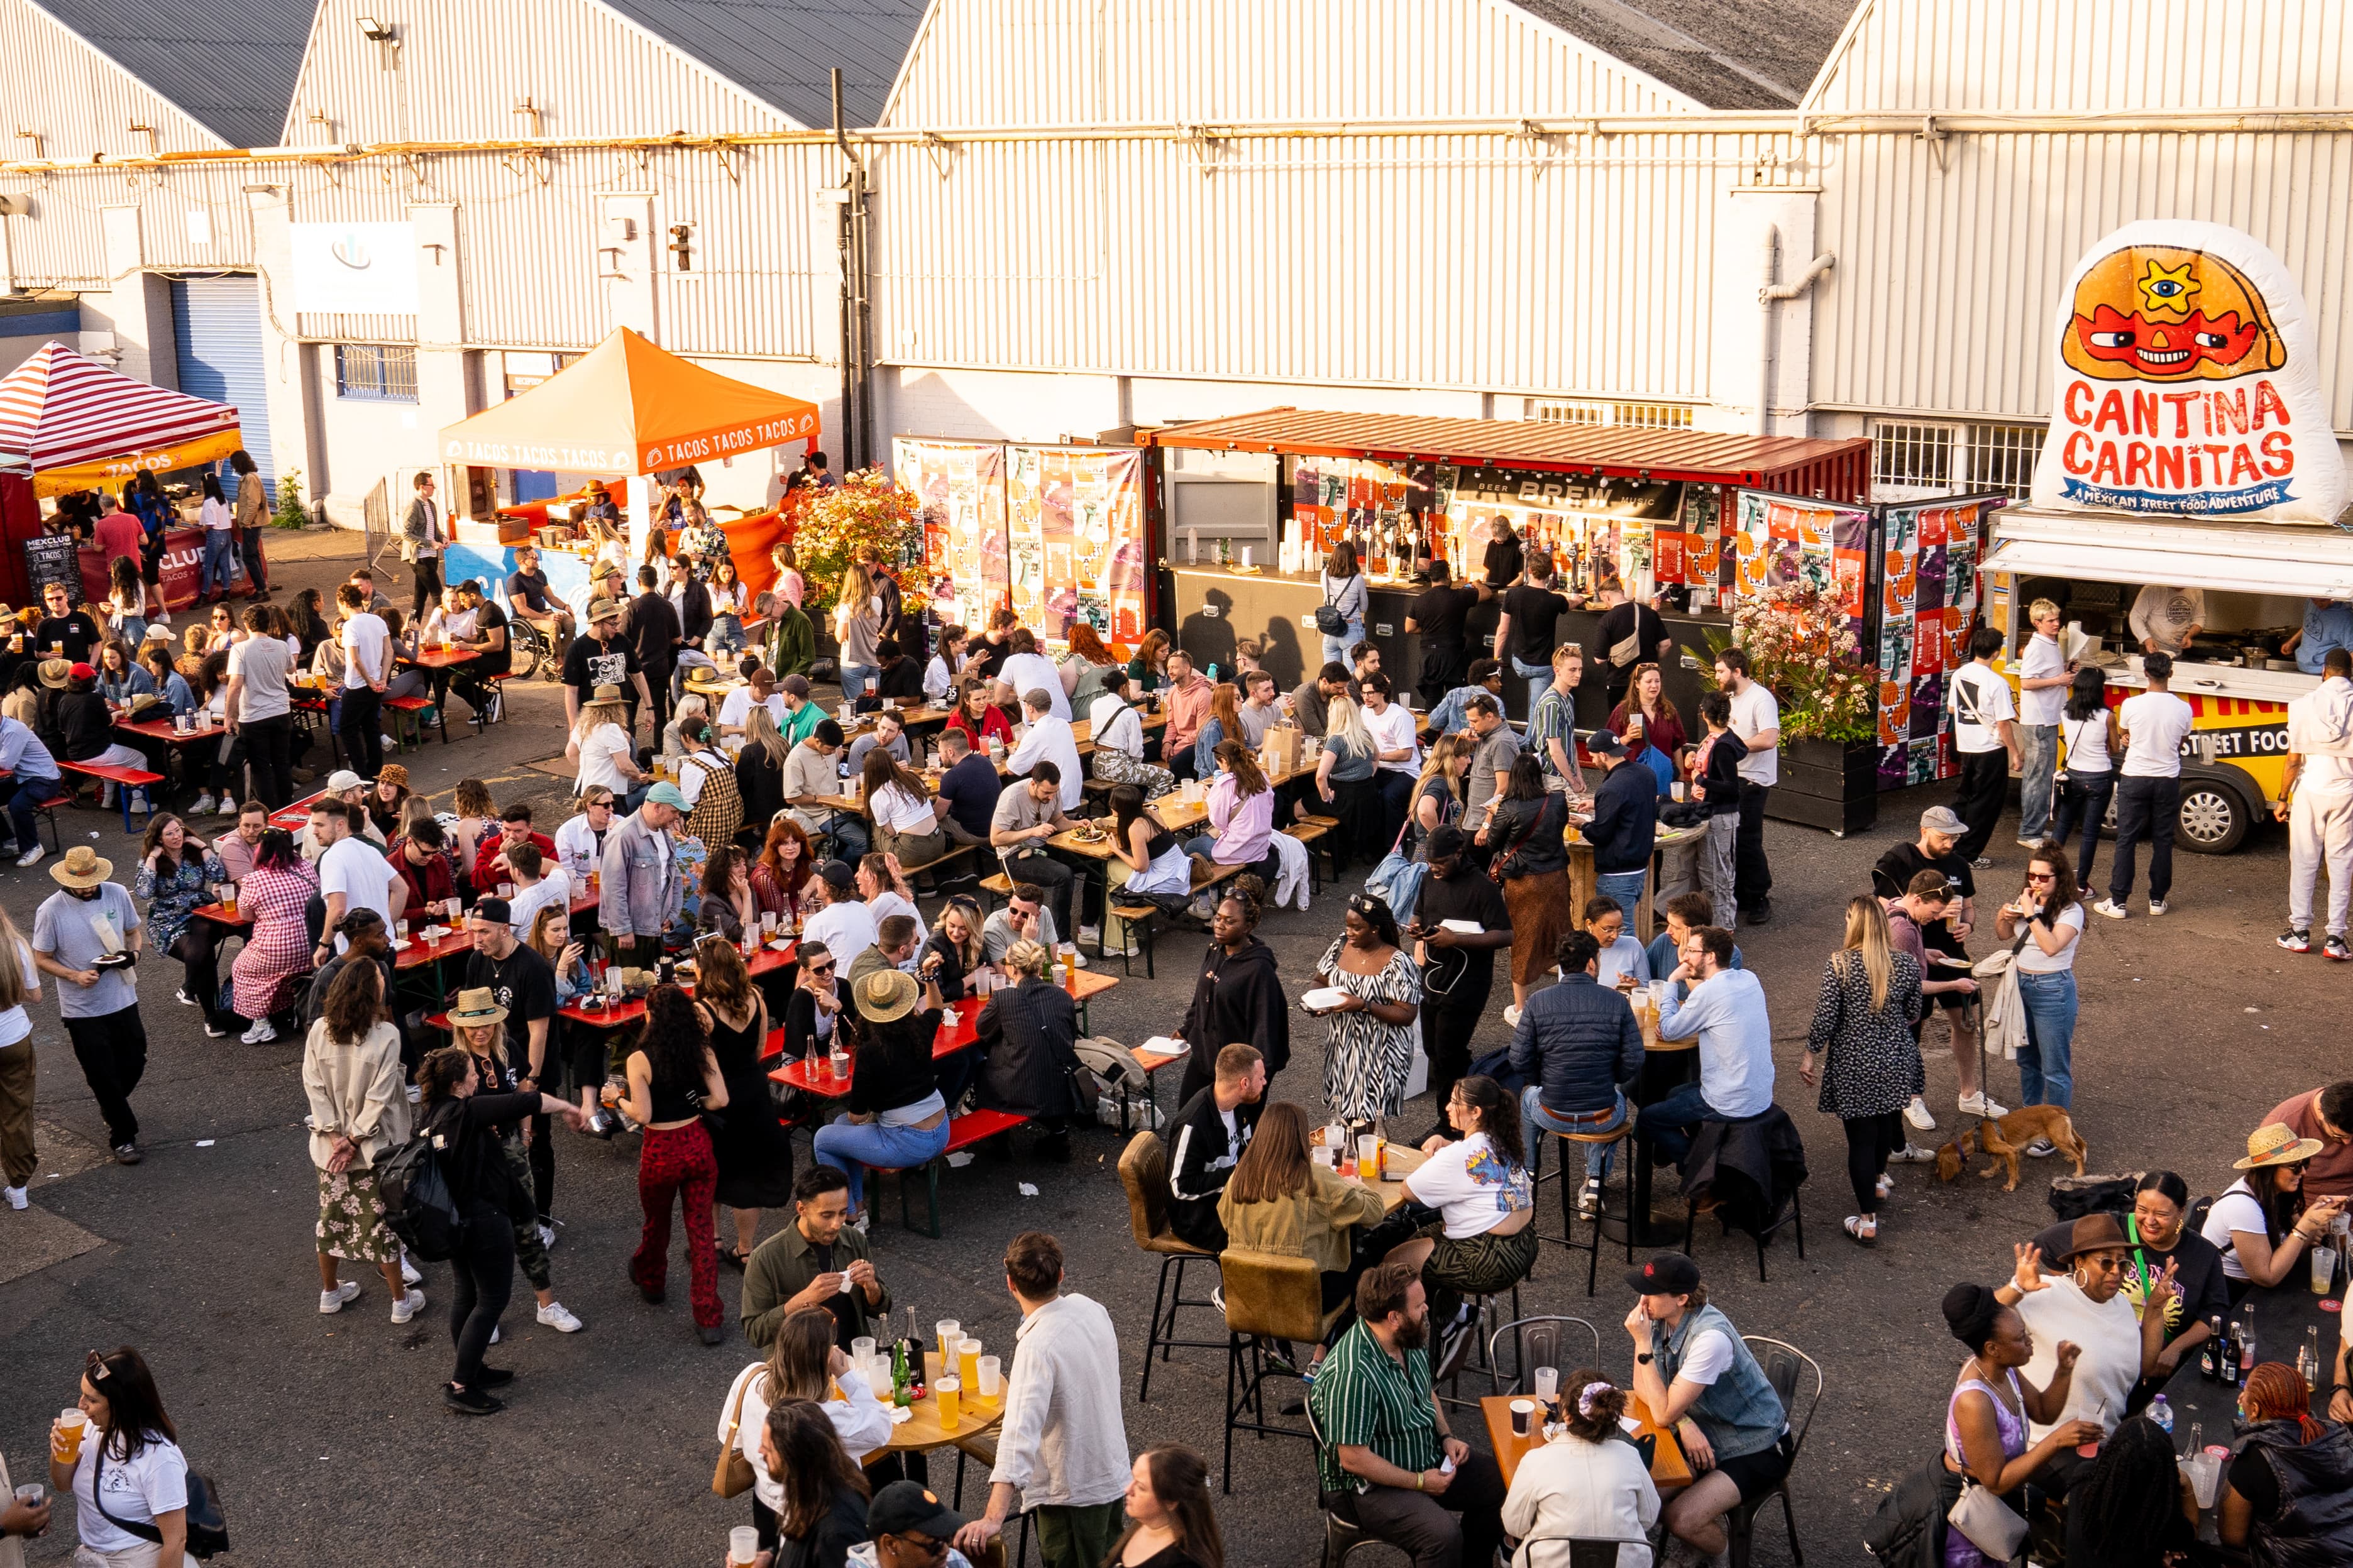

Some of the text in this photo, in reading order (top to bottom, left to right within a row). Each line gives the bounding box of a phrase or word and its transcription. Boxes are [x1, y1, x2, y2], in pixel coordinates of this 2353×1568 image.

[667, 418, 795, 463] TACOS TACOS TACOS
[467, 441, 607, 468] TACOS TACOS TACOS
[106, 454, 172, 478] TACOS
[1479, 482, 1509, 493] BEER
[1518, 481, 1614, 508] BREW
[2141, 497, 2176, 510] STREET
[2180, 500, 2208, 510] FOOD
[2208, 487, 2280, 510] ADVENTURE
[1621, 496, 1655, 506] MUSIC
[26, 535, 70, 547] MEXCLUB
[1620, 536, 1652, 547] UNSUNG
[40, 551, 62, 560] TACOS
[161, 571, 188, 583] TACOS
[1077, 597, 1108, 608] UNSUNG
[948, 687, 957, 697] 35
[2251, 731, 2289, 752] FOO
